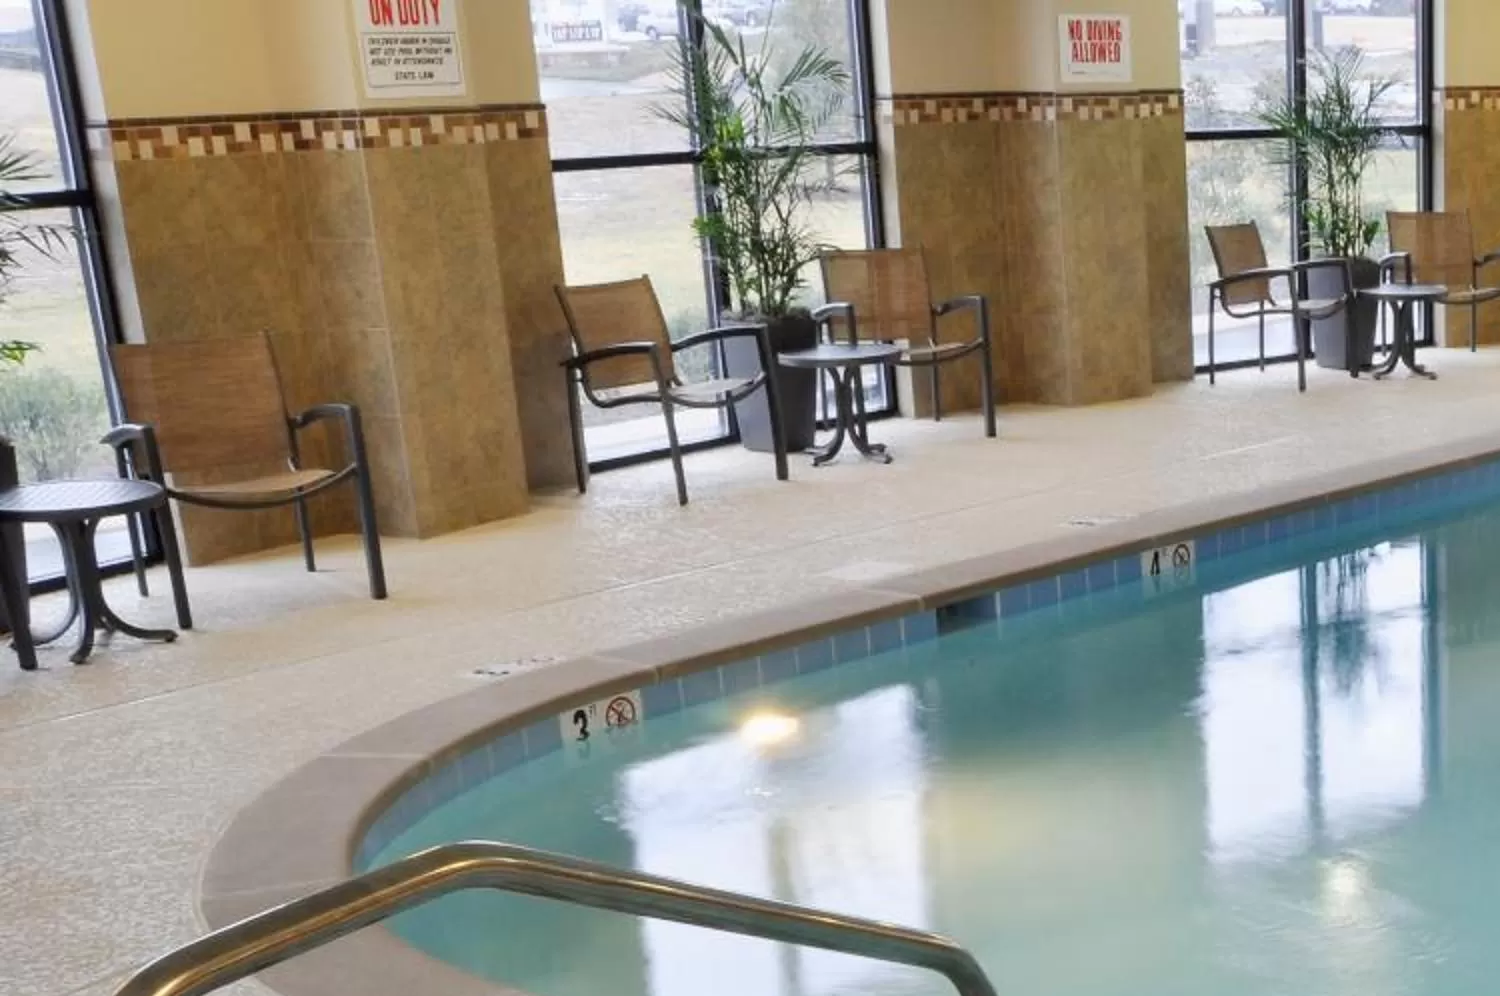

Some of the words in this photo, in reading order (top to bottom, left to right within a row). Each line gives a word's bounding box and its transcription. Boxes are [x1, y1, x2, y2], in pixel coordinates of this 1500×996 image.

[368, 0, 394, 26] ON
[397, 0, 441, 25] DUTY
[1067, 19, 1083, 41] NO
[1086, 19, 1122, 41] DIVING
[1071, 41, 1121, 63] ALLOWED
